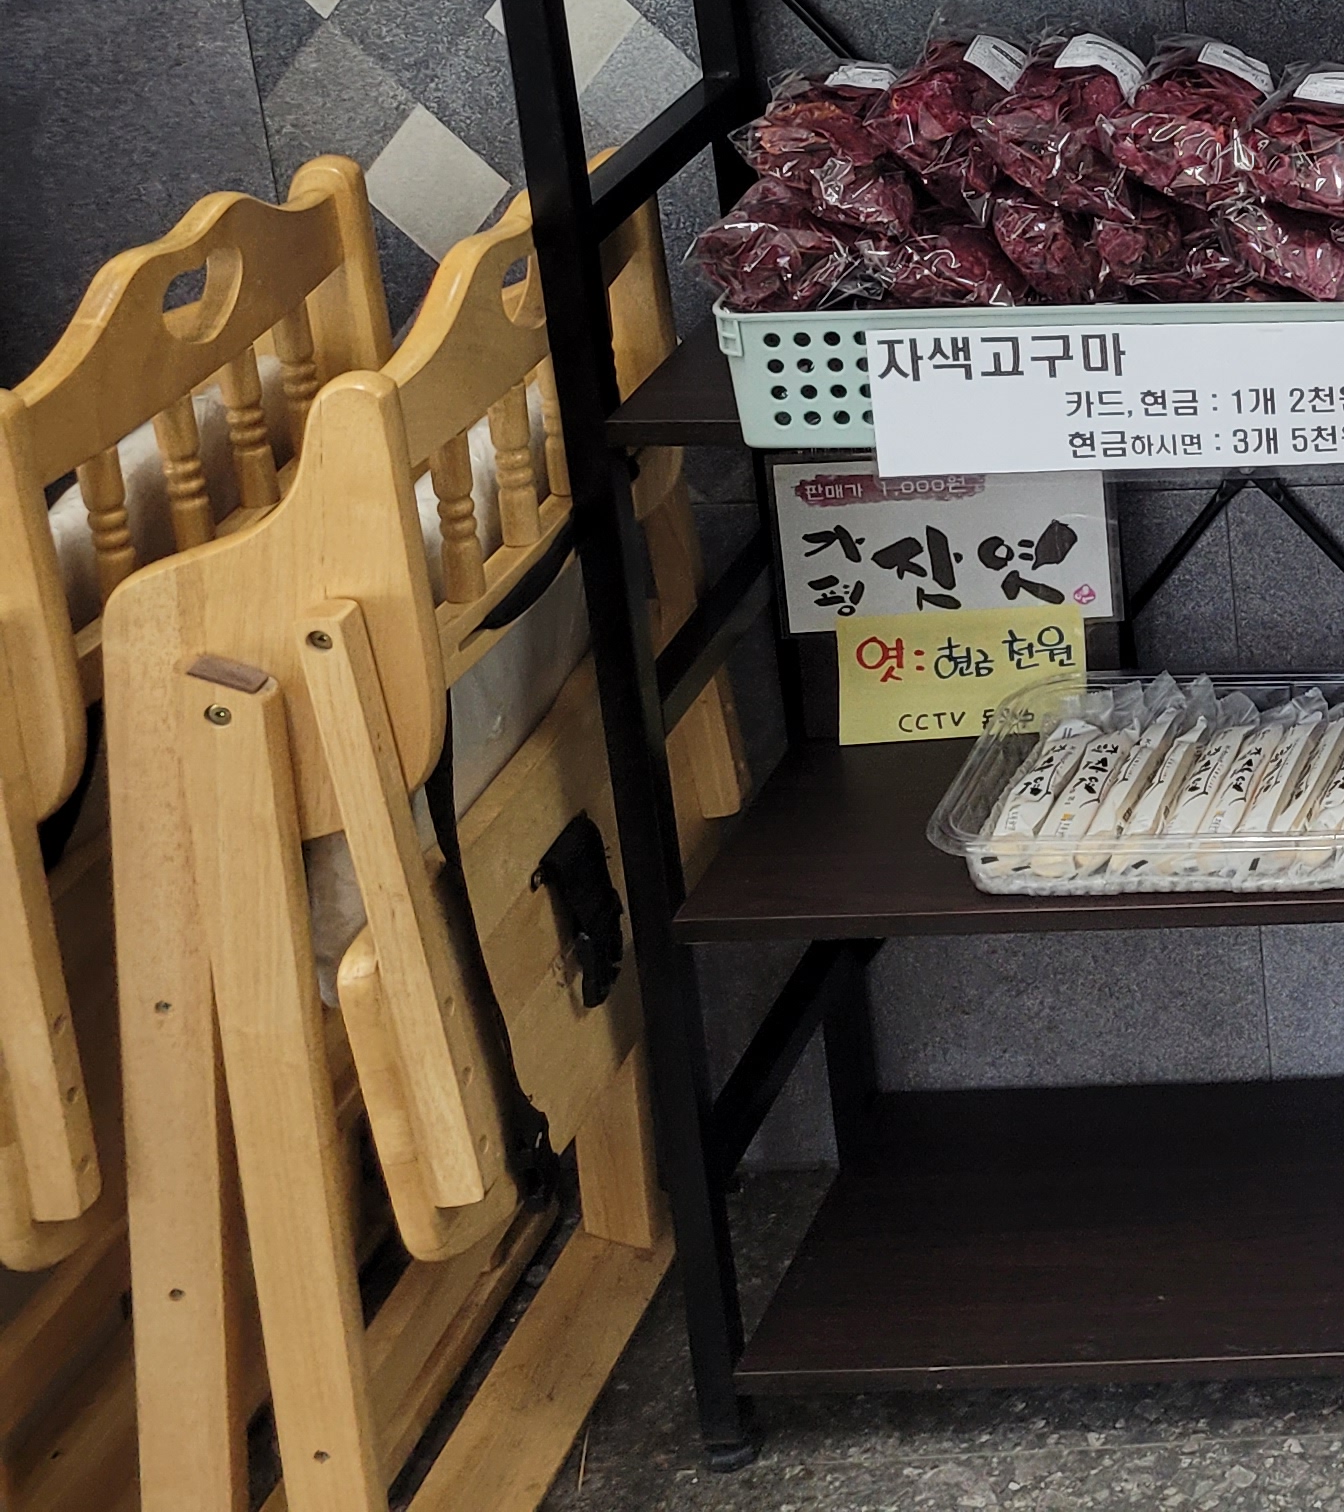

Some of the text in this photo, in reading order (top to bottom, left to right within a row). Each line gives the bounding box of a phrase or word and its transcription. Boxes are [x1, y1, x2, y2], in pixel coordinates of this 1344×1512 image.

[876, 331, 1127, 383] 자색고구마
[1230, 386, 1278, 418] 1개
[1066, 428, 1204, 460] 현금하시면
[1231, 425, 1280, 457] 3개
[933, 636, 995, 680] 현금
[1001, 624, 1077, 671] 천원
[898, 710, 967, 734] CCTV
